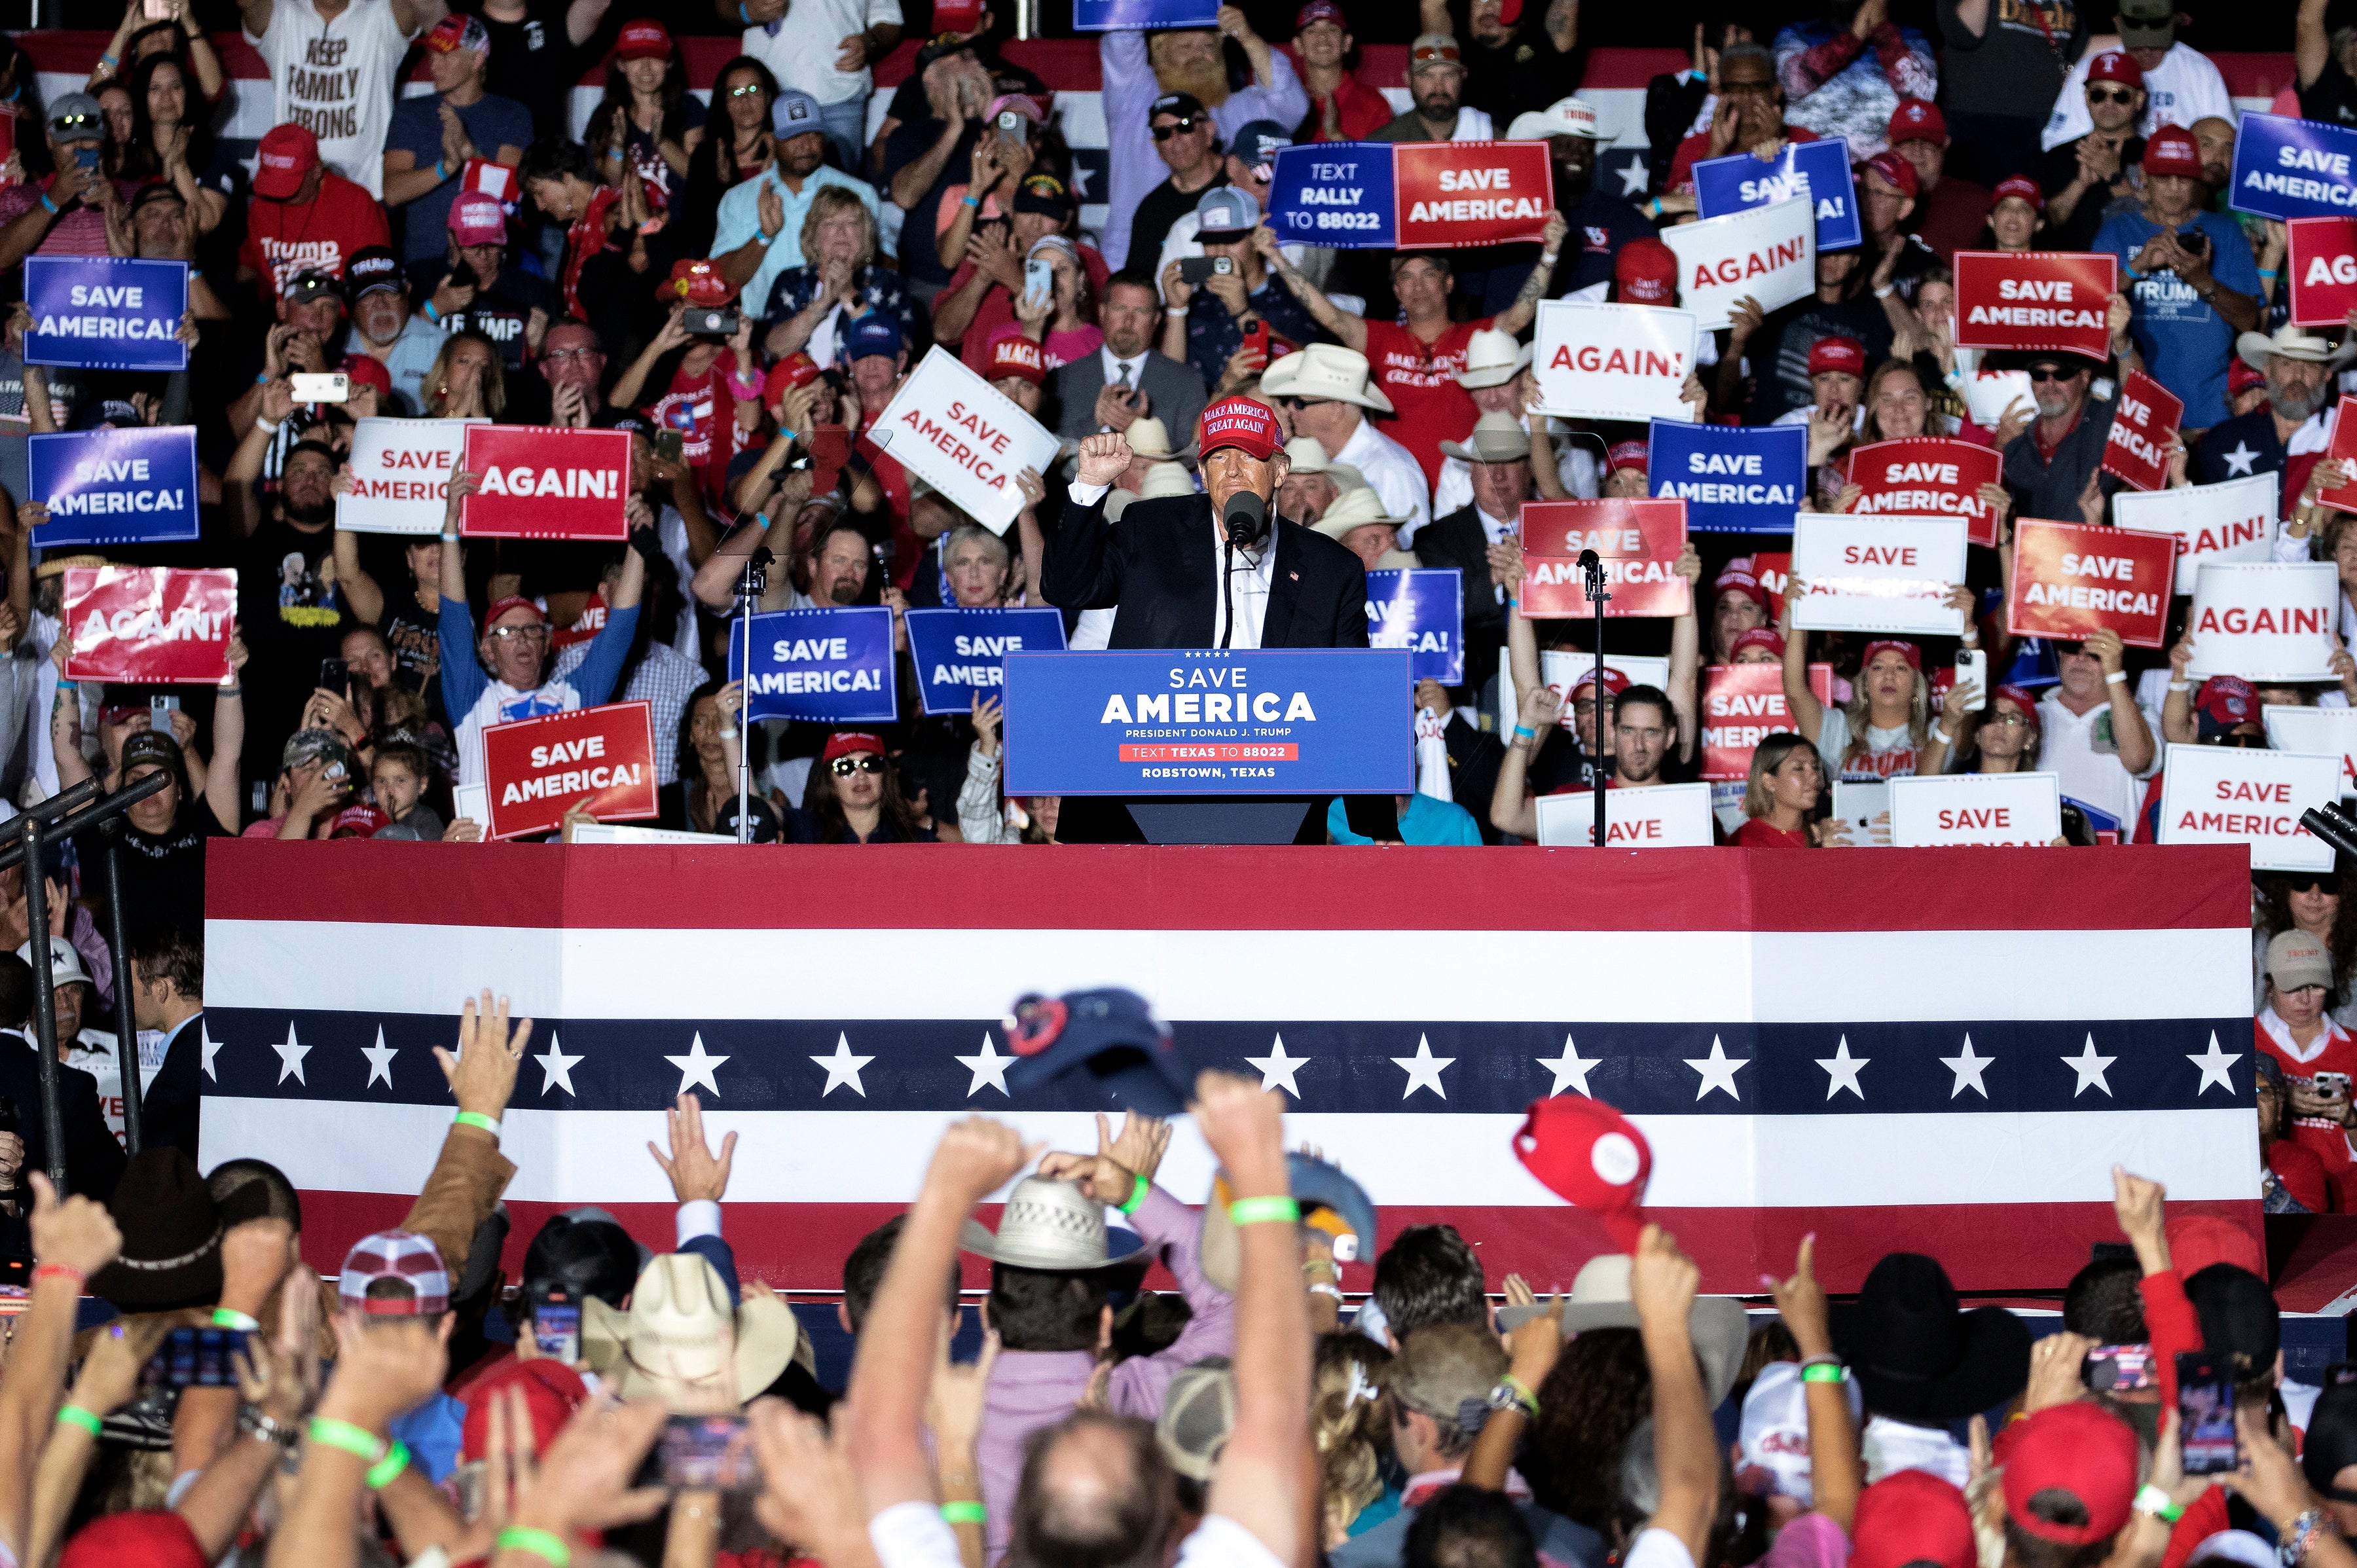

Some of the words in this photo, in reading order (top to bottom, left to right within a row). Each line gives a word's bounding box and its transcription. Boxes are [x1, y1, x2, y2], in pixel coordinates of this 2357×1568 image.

[1311, 163, 1359, 181] TEXT
[2277, 146, 2351, 177] SAVE
[1438, 168, 1511, 192] SAVE
[1300, 187, 1364, 206] RALLY
[1285, 211, 1314, 229] TO
[1316, 212, 1380, 230] 88022
[1409, 196, 1543, 223] AMERICA!
[260, 236, 340, 263] Trump
[1693, 236, 1806, 291] AGAIN!
[70, 285, 144, 308] SAVE
[1999, 280, 2073, 303] SAVE
[37, 314, 175, 341] AMERICA!
[1967, 304, 2105, 329] AMERICA!
[1549, 344, 1683, 378] AGAIN!
[1203, 405, 1227, 424] MAKE
[1226, 403, 1270, 421] AMERICA
[2115, 392, 2151, 428] AVE
[947, 399, 1012, 456] SAVE
[1207, 418, 1234, 436] GREAT
[1233, 418, 1264, 435] AGAIN
[382, 450, 451, 469] SAVE
[900, 409, 1008, 492] AMERICA
[75, 459, 151, 483] SAVE
[1689, 452, 1763, 476] SAVE
[1885, 463, 1960, 485] SAVE
[478, 465, 619, 500] AGAIN!
[1656, 481, 1795, 506] AMERICA!
[46, 488, 185, 517] AMERICA!
[1853, 488, 1986, 519] AMERICA!
[1565, 529, 1641, 551] SAVE
[2176, 515, 2266, 556] GAIN!
[1844, 545, 1919, 567] SAVE
[2061, 553, 2134, 582] SAVE
[1367, 599, 1416, 622] AVE
[2024, 582, 2160, 617] AMERICA!
[81, 609, 223, 642] AGAIN!
[2197, 606, 2329, 635] AGAIN!
[772, 638, 849, 663] SAVE
[955, 634, 1023, 657] SAVE
[749, 668, 881, 696] AMERICA!
[1169, 667, 1247, 689] SAVE
[1100, 691, 1317, 724] AMERICA
[1711, 695, 1786, 716] SAVE
[1125, 728, 1186, 738] PRESIDENT
[1190, 728, 1238, 738] DONALD
[1241, 727, 1251, 737] J.
[1253, 727, 1292, 737] TRUMP
[530, 735, 605, 769] SAVE
[1131, 747, 1167, 758] TEXT
[1171, 746, 1216, 758] TEXAS
[1219, 746, 1239, 758] TO
[1243, 746, 1286, 758] 88022
[501, 761, 642, 807] AMERICA!
[1142, 767, 1226, 780] ROBSTOWN,
[1230, 767, 1276, 778] TEXAS
[2216, 780, 2293, 804] SAVE
[1938, 807, 2011, 830] SAVE
[2178, 810, 2314, 838] AMERICA
